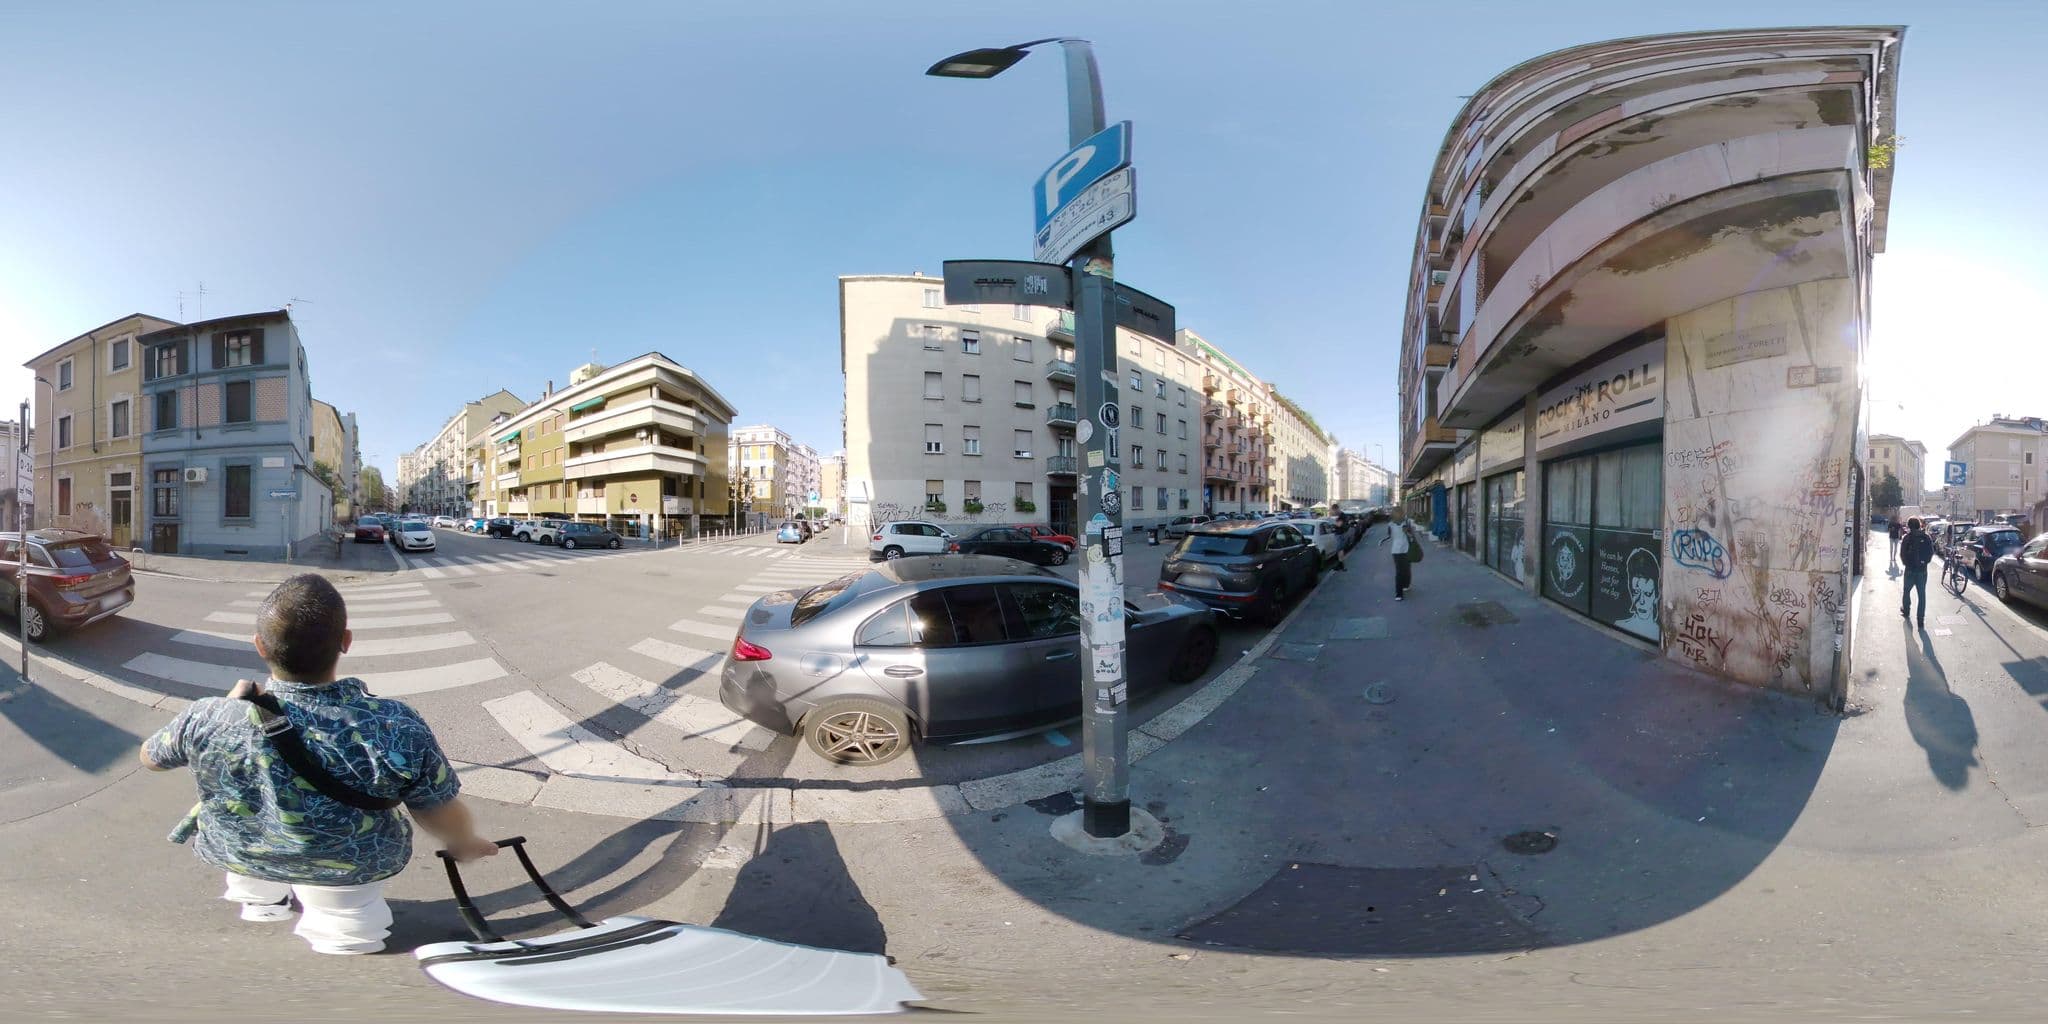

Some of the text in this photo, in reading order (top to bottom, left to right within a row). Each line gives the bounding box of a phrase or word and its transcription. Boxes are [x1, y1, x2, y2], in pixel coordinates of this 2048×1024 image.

[1045, 145, 1097, 218] P
[1099, 209, 1114, 225] 43
[1540, 395, 1578, 427] ROCK
[1598, 363, 1657, 404] ROLL
[1562, 409, 1611, 432] MILANO
[1950, 464, 1962, 482] P
